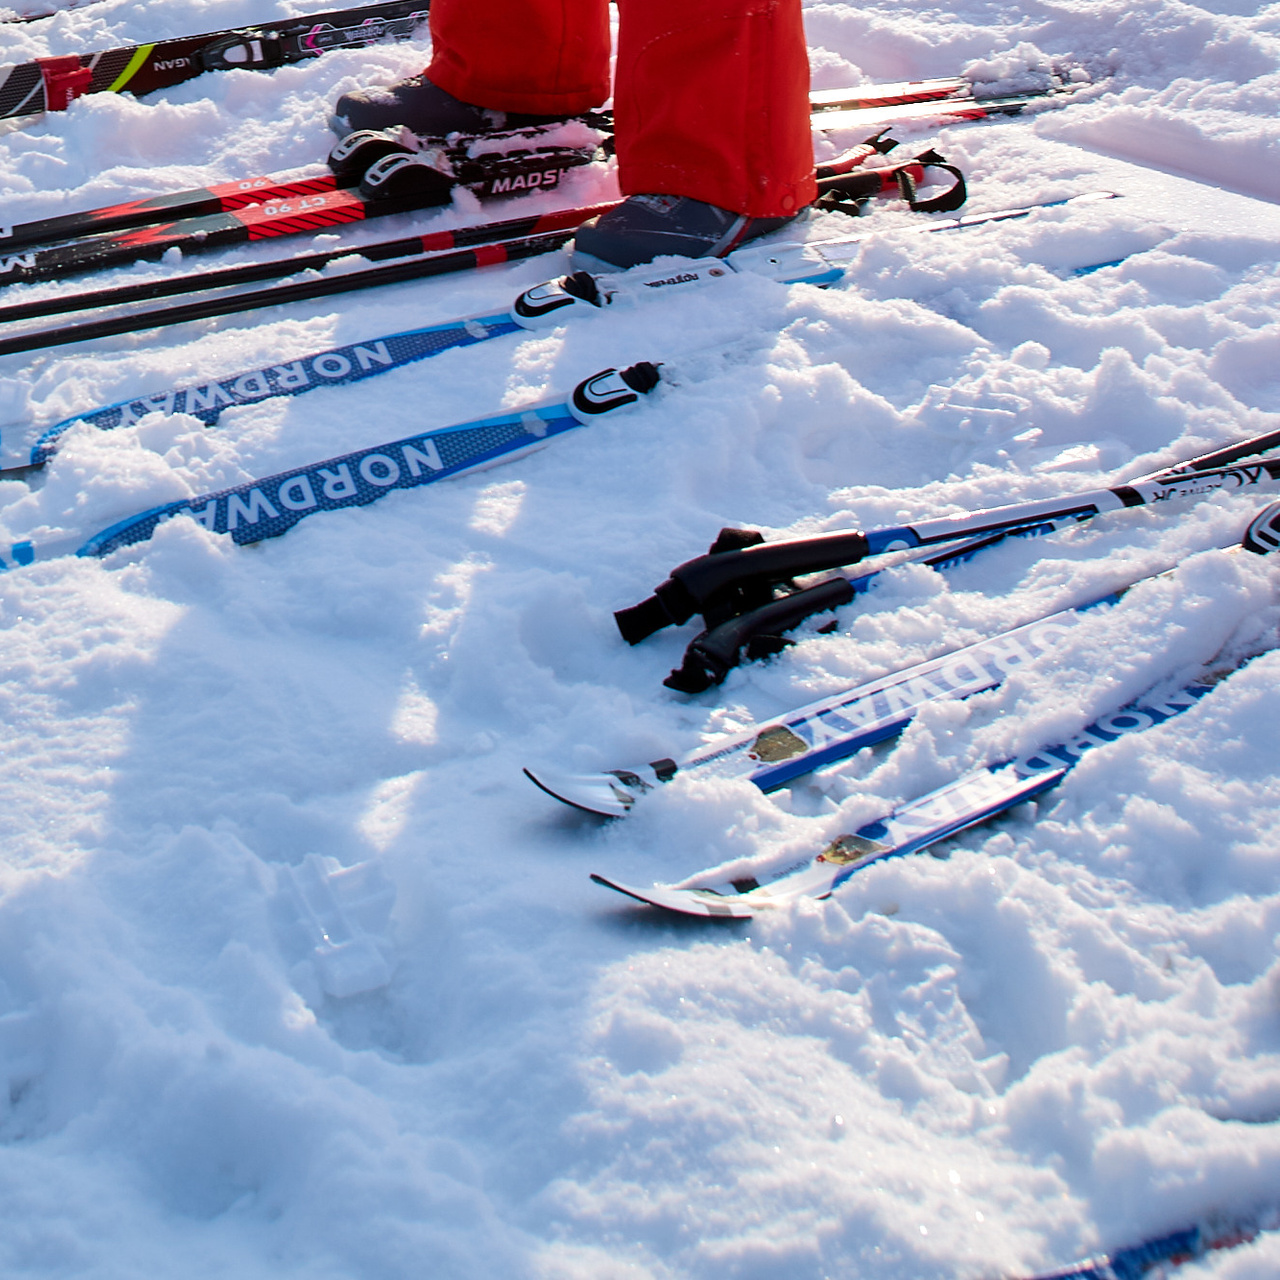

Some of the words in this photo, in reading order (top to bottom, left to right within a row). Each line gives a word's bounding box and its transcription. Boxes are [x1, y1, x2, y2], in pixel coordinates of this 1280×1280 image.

[264, 204, 293, 216] 90
[298, 197, 326, 210] CT
[160, 438, 444, 533] NORDWA
[805, 623, 1071, 747] ORDWAY
